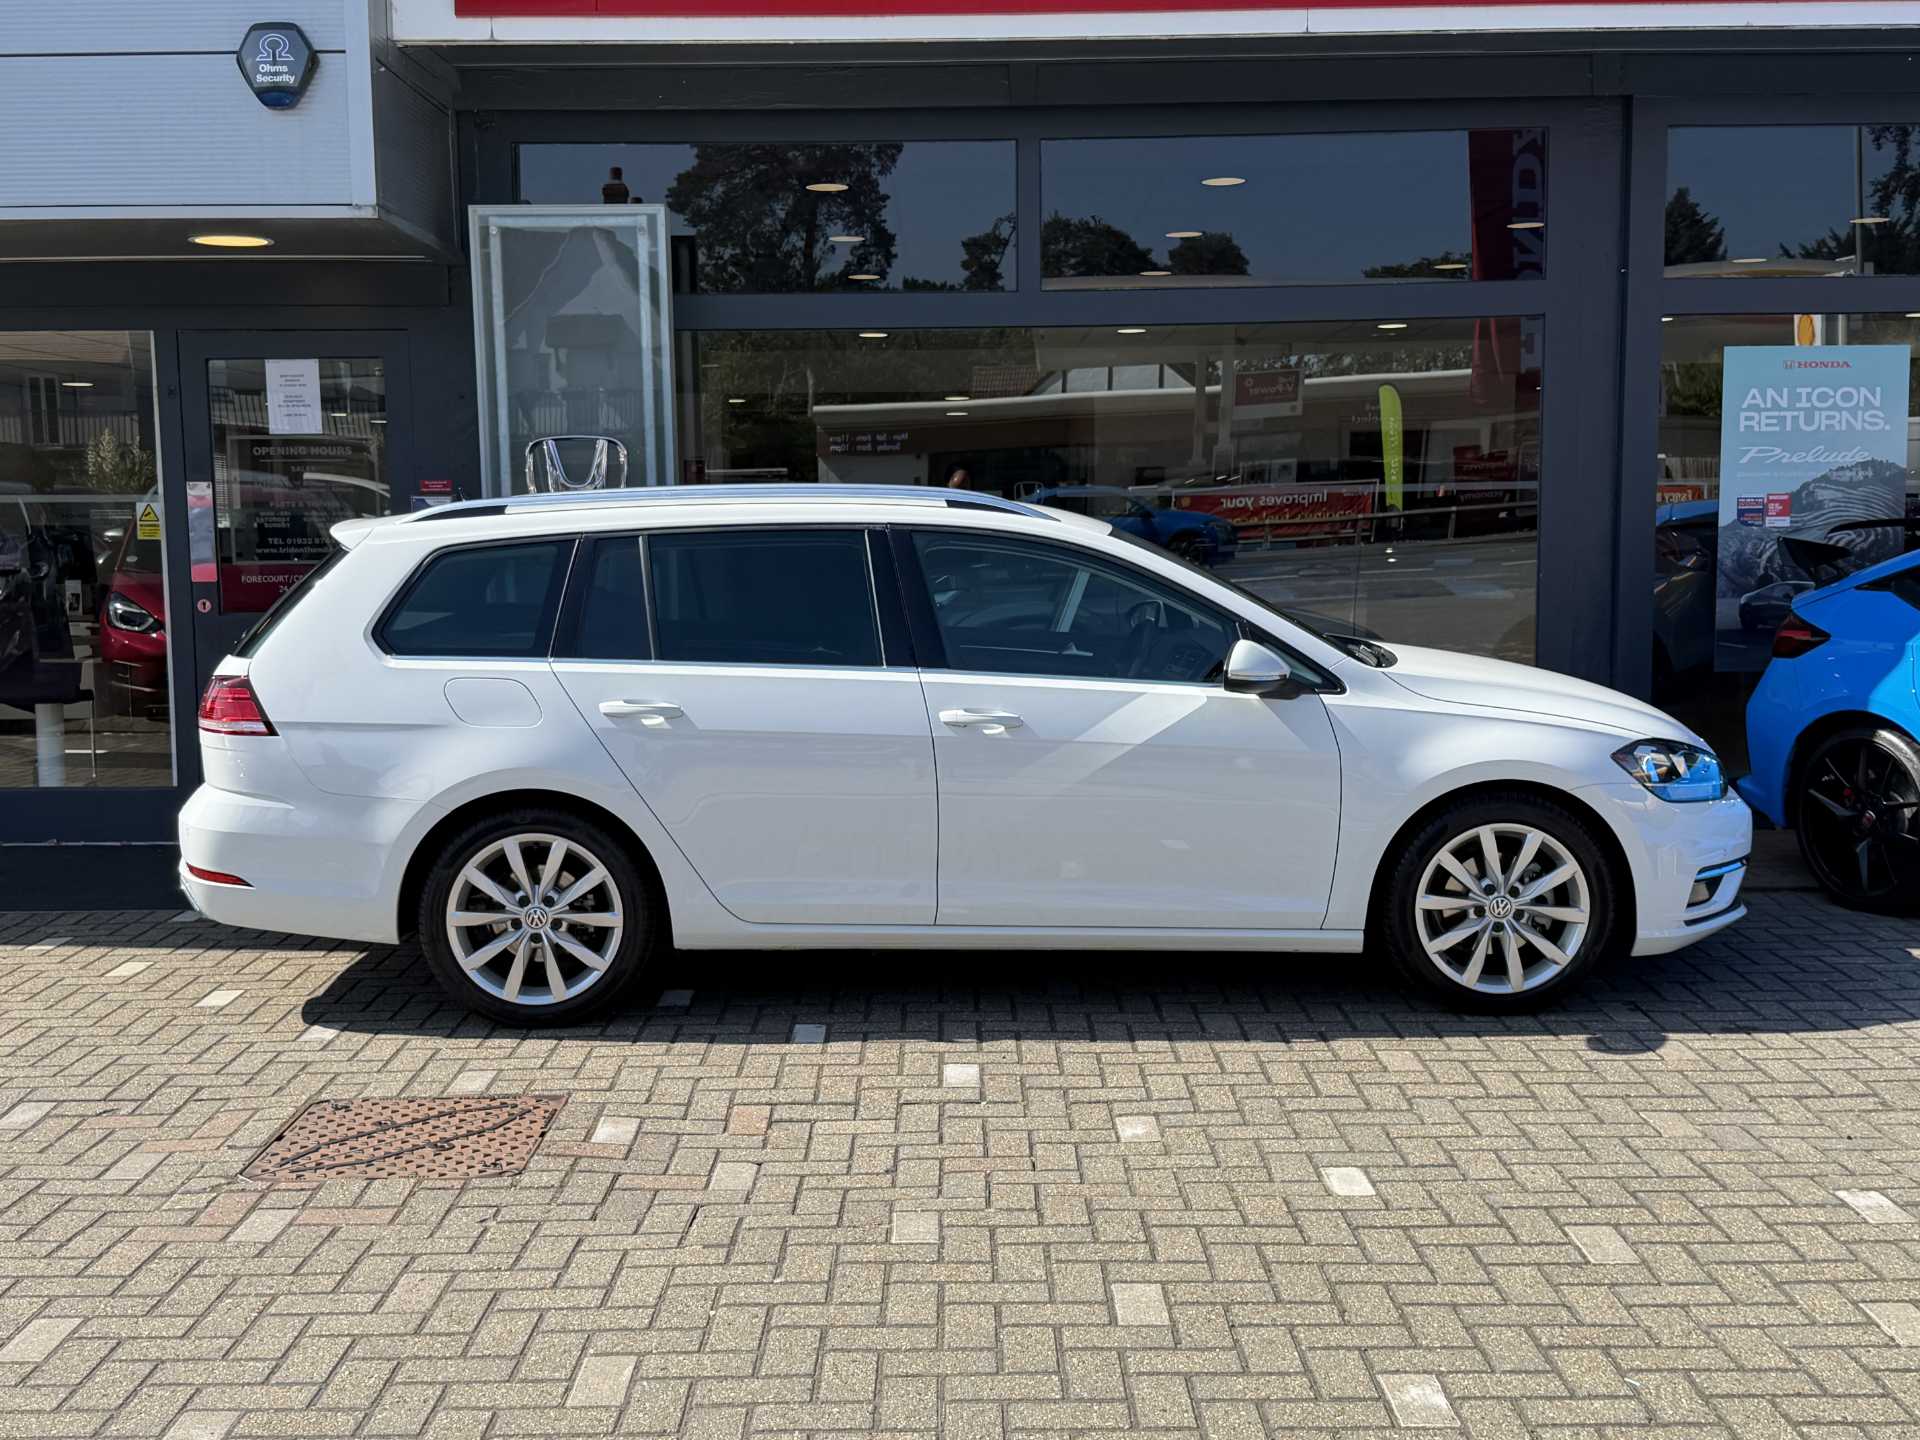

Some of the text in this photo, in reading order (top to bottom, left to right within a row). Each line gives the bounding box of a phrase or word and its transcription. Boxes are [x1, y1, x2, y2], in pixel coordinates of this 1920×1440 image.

[259, 64, 288, 72] Ohms
[256, 74, 295, 83] Security
[1797, 361, 1852, 369] HONDA
[1741, 386, 1881, 409] AN ICON
[1739, 410, 1891, 432] RETURNS.
[252, 446, 352, 456] OPENING HOURS
[1737, 446, 1872, 464] Prelude
